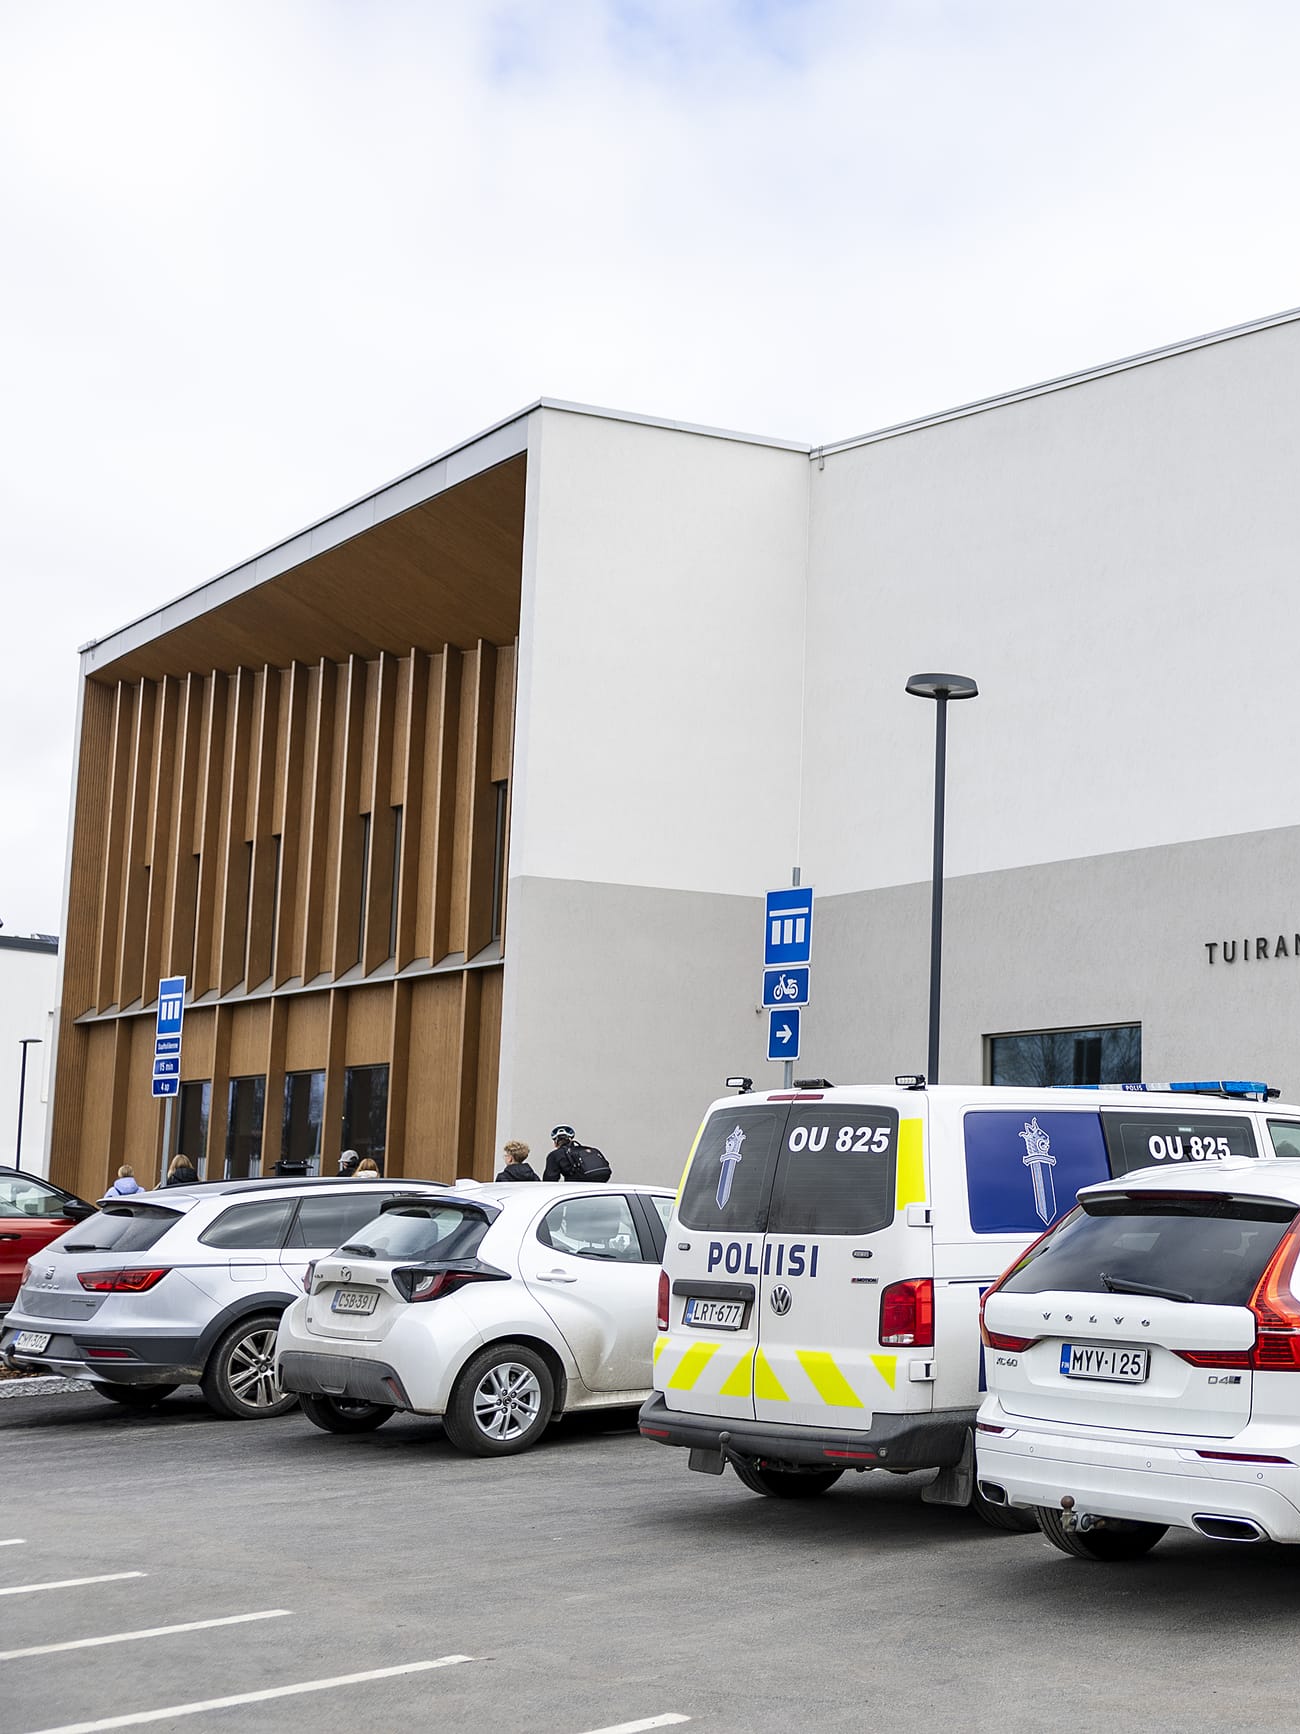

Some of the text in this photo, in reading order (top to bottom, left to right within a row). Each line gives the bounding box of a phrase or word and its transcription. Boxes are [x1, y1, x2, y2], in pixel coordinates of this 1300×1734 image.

[788, 1126, 891, 1153] OU 825
[1148, 1135, 1231, 1160] OU 825
[707, 1241, 819, 1278] POLIISI
[338, 1293, 374, 1310] CSB-391
[693, 1302, 740, 1323] LRT-677
[1042, 1311, 1151, 1328] VOLVO
[996, 1357, 1018, 1367] XC60
[1072, 1349, 1142, 1376] MYV-125
